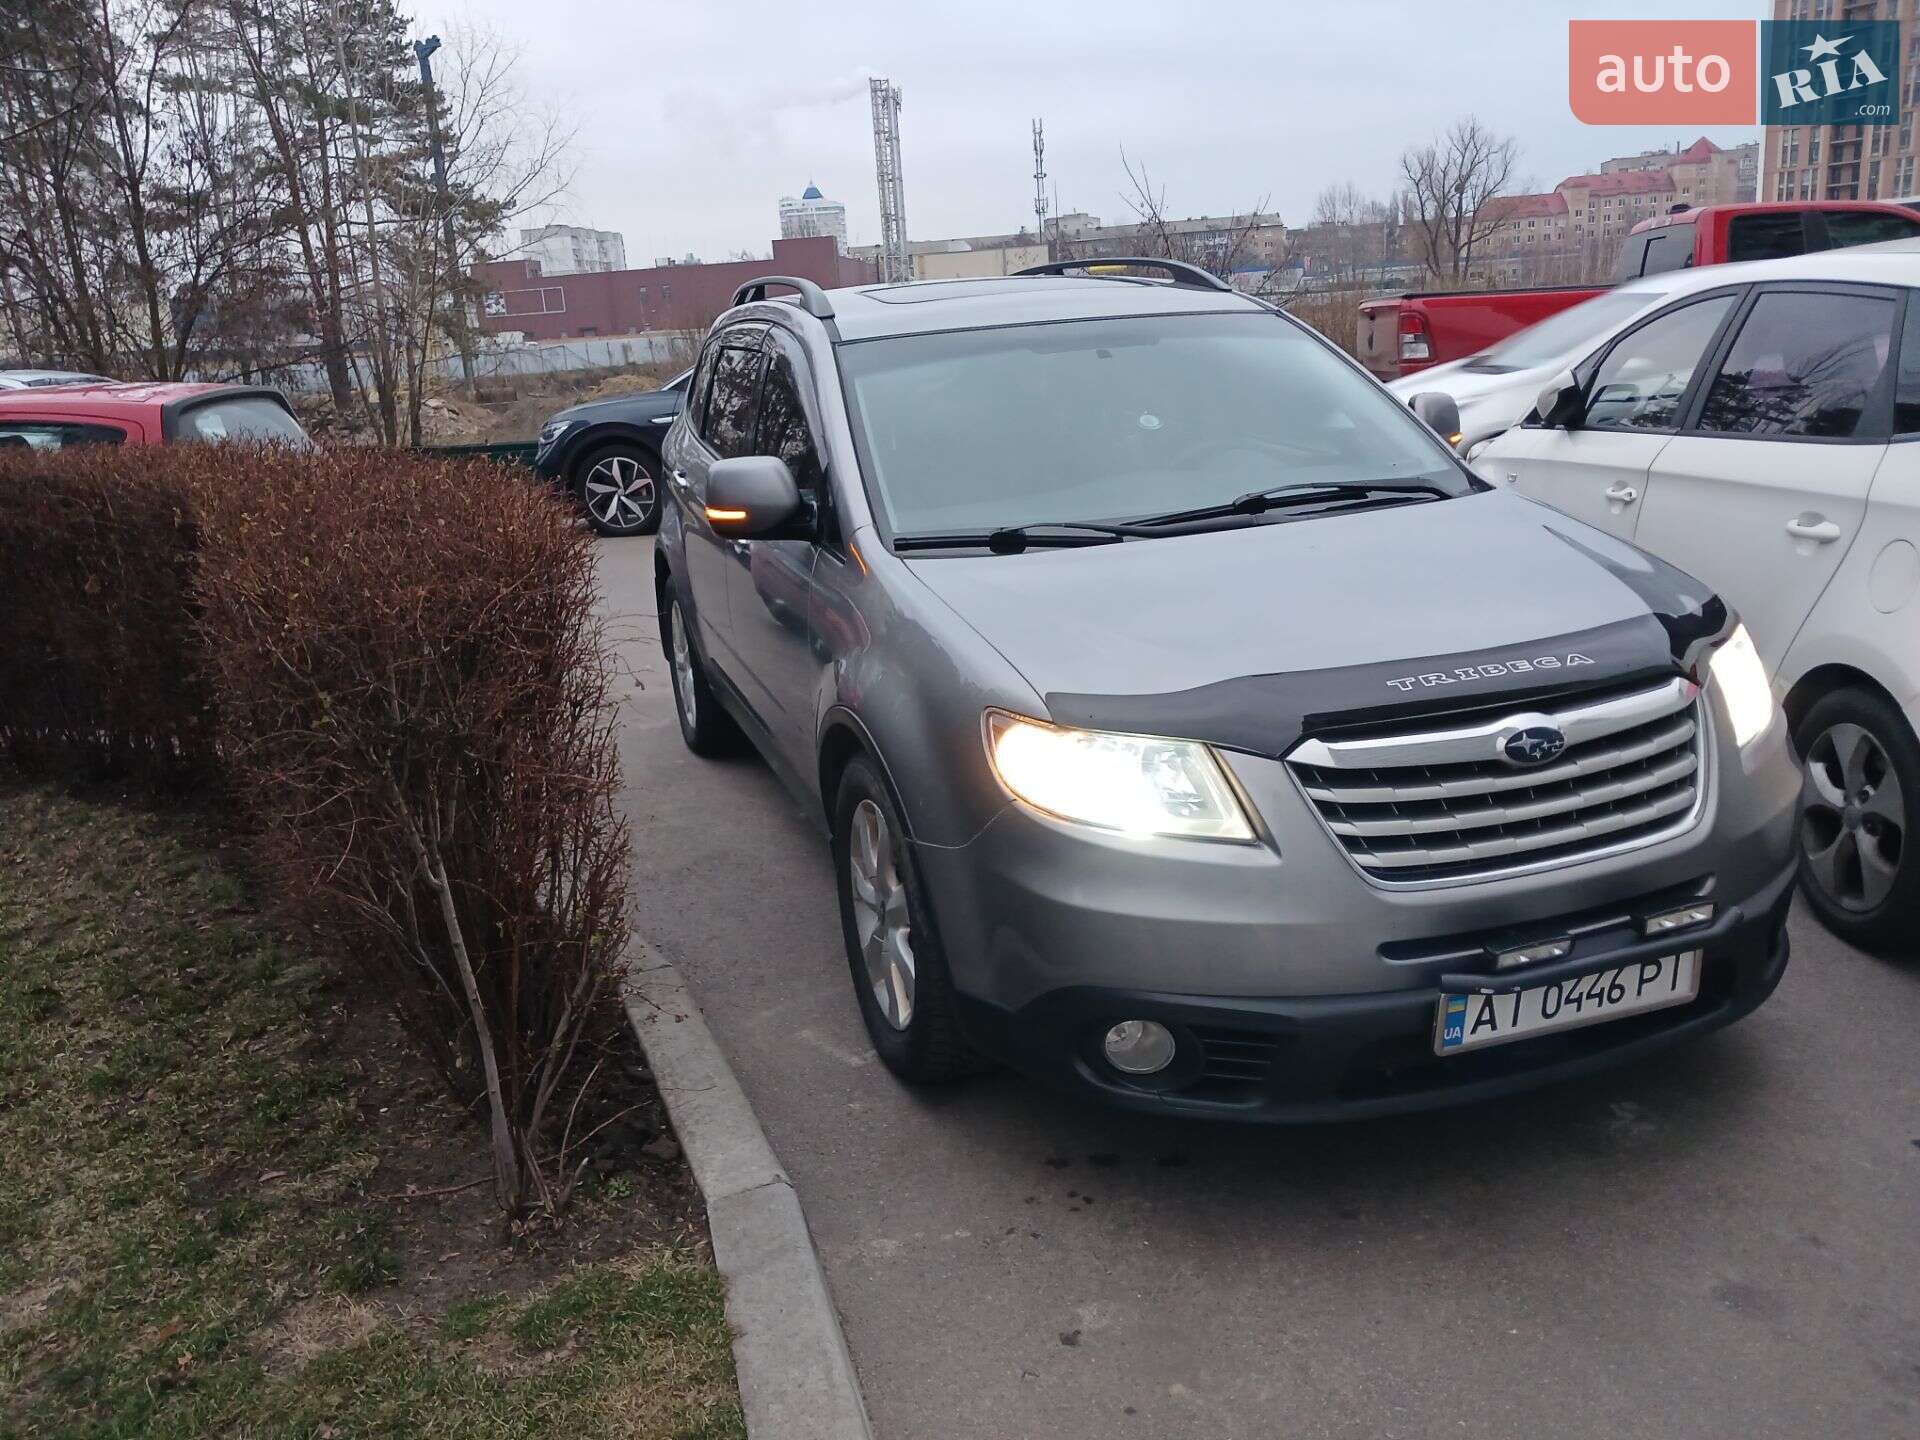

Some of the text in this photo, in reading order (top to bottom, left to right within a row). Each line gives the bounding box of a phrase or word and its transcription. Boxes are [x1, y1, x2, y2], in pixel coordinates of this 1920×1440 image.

[1386, 653, 1596, 692] TRIBECA
[1541, 966, 1627, 1020] 0446
[1443, 1025, 1463, 1040] UA
